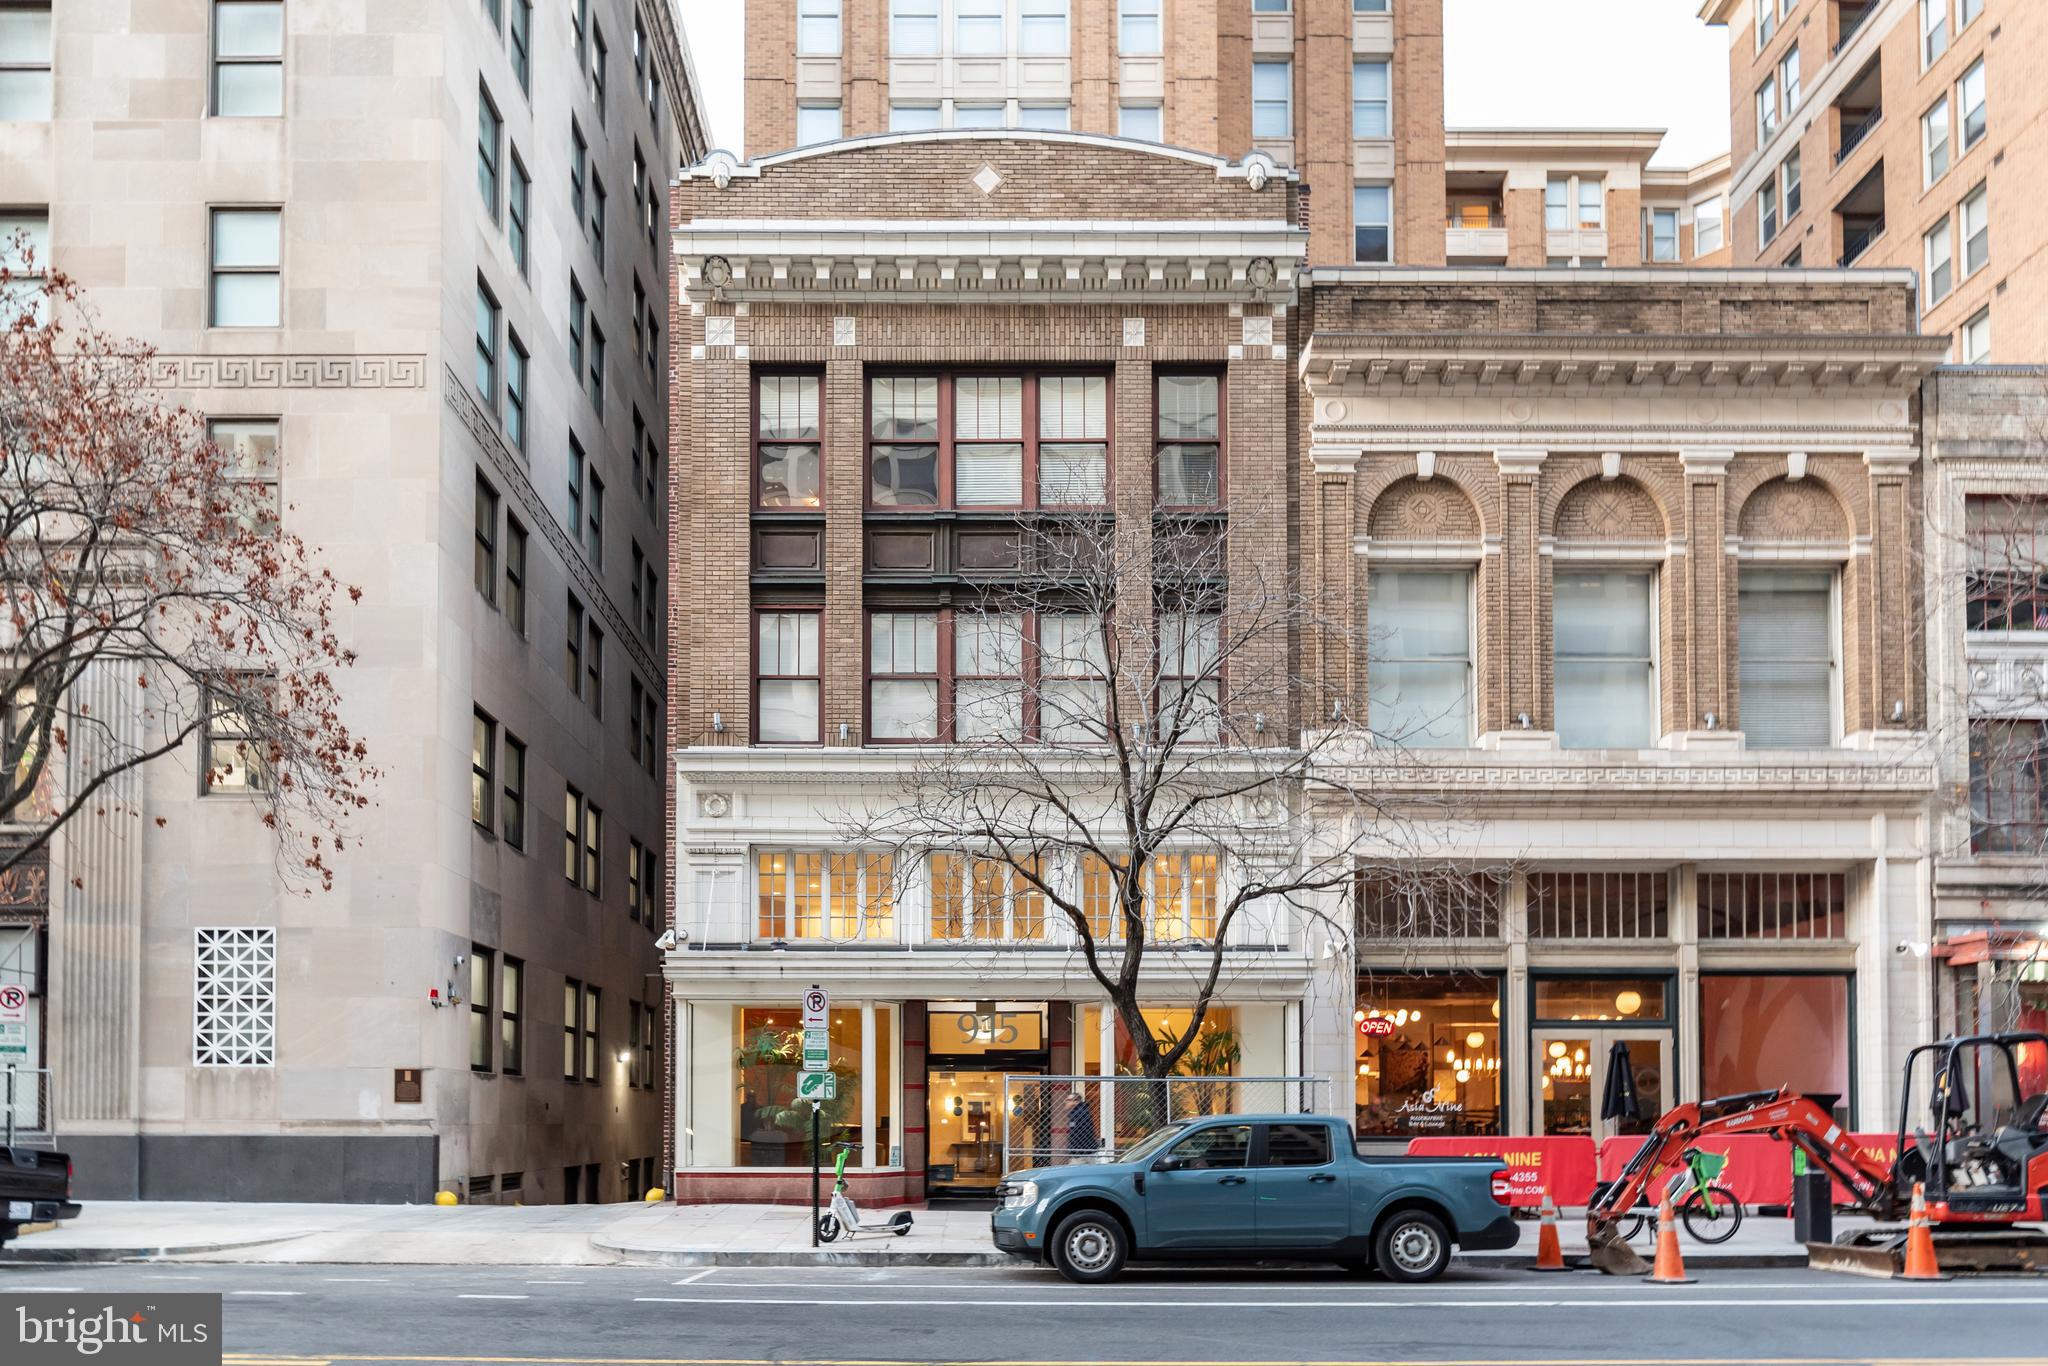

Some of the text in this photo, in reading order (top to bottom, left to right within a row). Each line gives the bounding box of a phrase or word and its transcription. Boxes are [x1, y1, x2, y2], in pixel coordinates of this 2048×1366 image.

[957, 1014, 1018, 1043] 915
[1361, 1021, 1393, 1034] OPEN
[1394, 1100, 1463, 1112] Asia Nine
[1504, 1152, 1542, 1167] NINE
